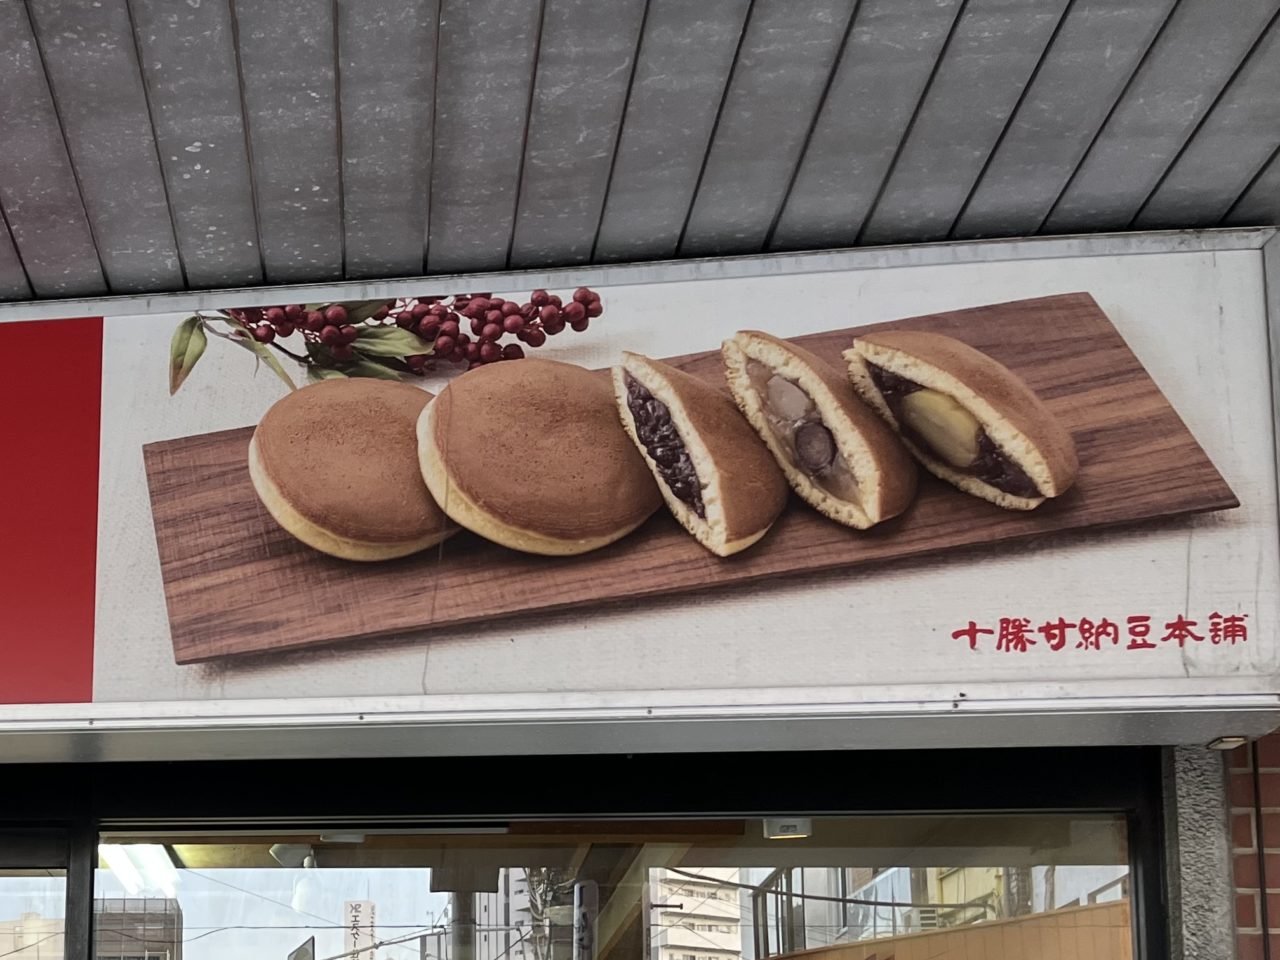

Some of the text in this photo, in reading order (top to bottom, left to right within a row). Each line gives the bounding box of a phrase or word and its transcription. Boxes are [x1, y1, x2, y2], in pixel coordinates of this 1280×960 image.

[951, 612, 1248, 653] 十勝甘納豆本舗
